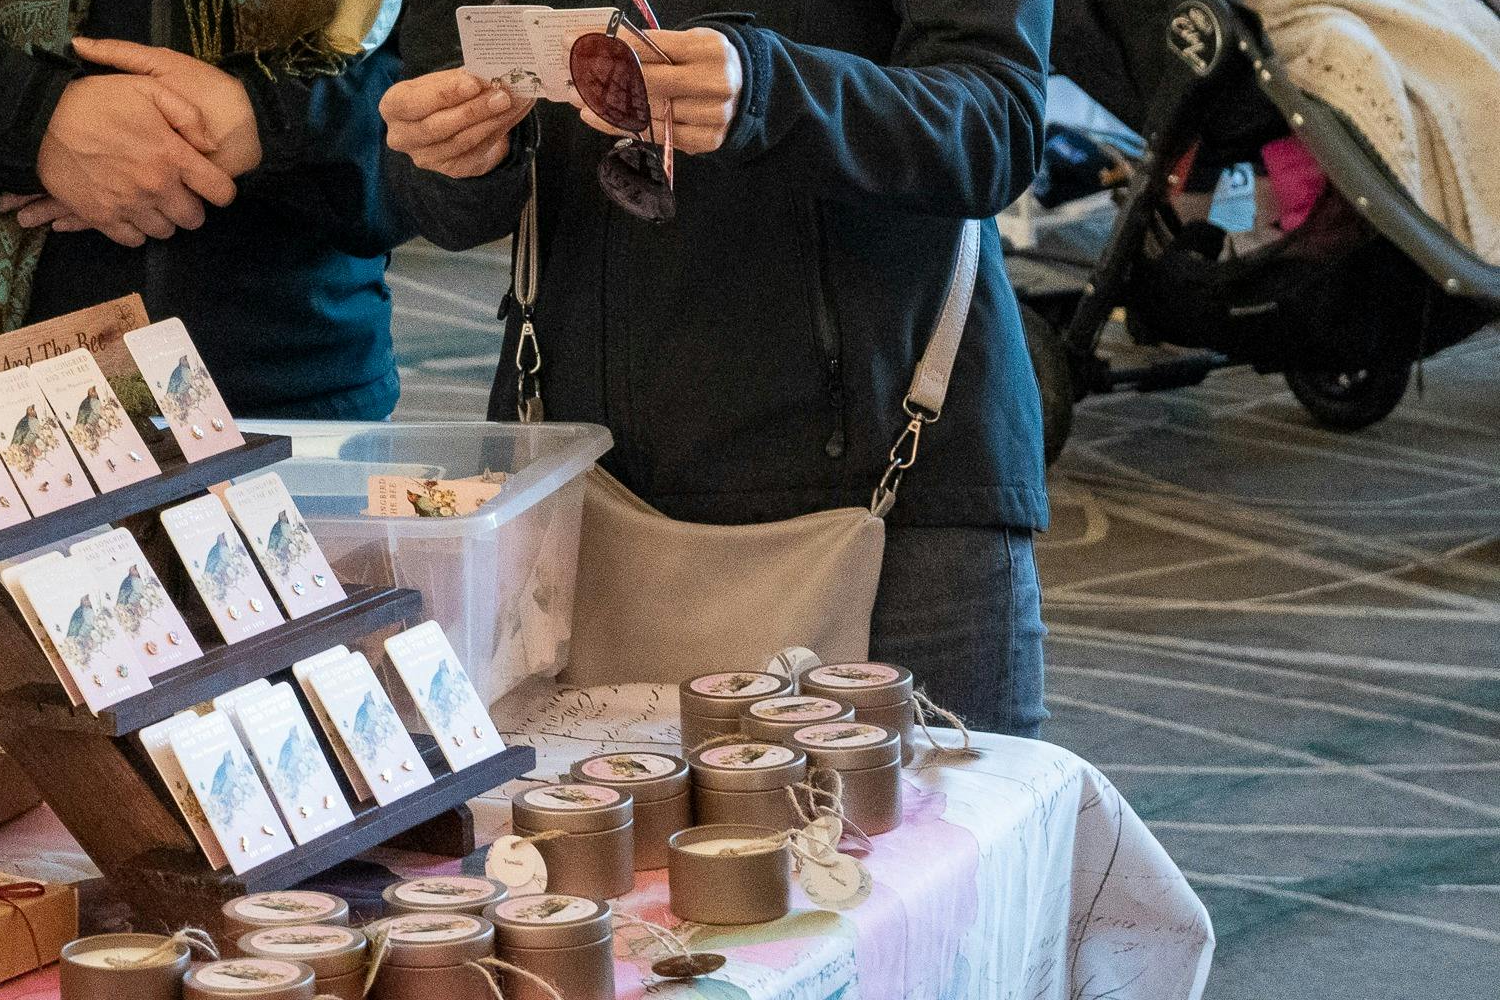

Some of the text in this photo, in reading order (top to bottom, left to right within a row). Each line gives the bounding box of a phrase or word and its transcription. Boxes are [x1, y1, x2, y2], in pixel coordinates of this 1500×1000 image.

[37, 338, 71, 363] The
[75, 331, 106, 352] Bee
[379, 478, 387, 516] ONGBIRD
